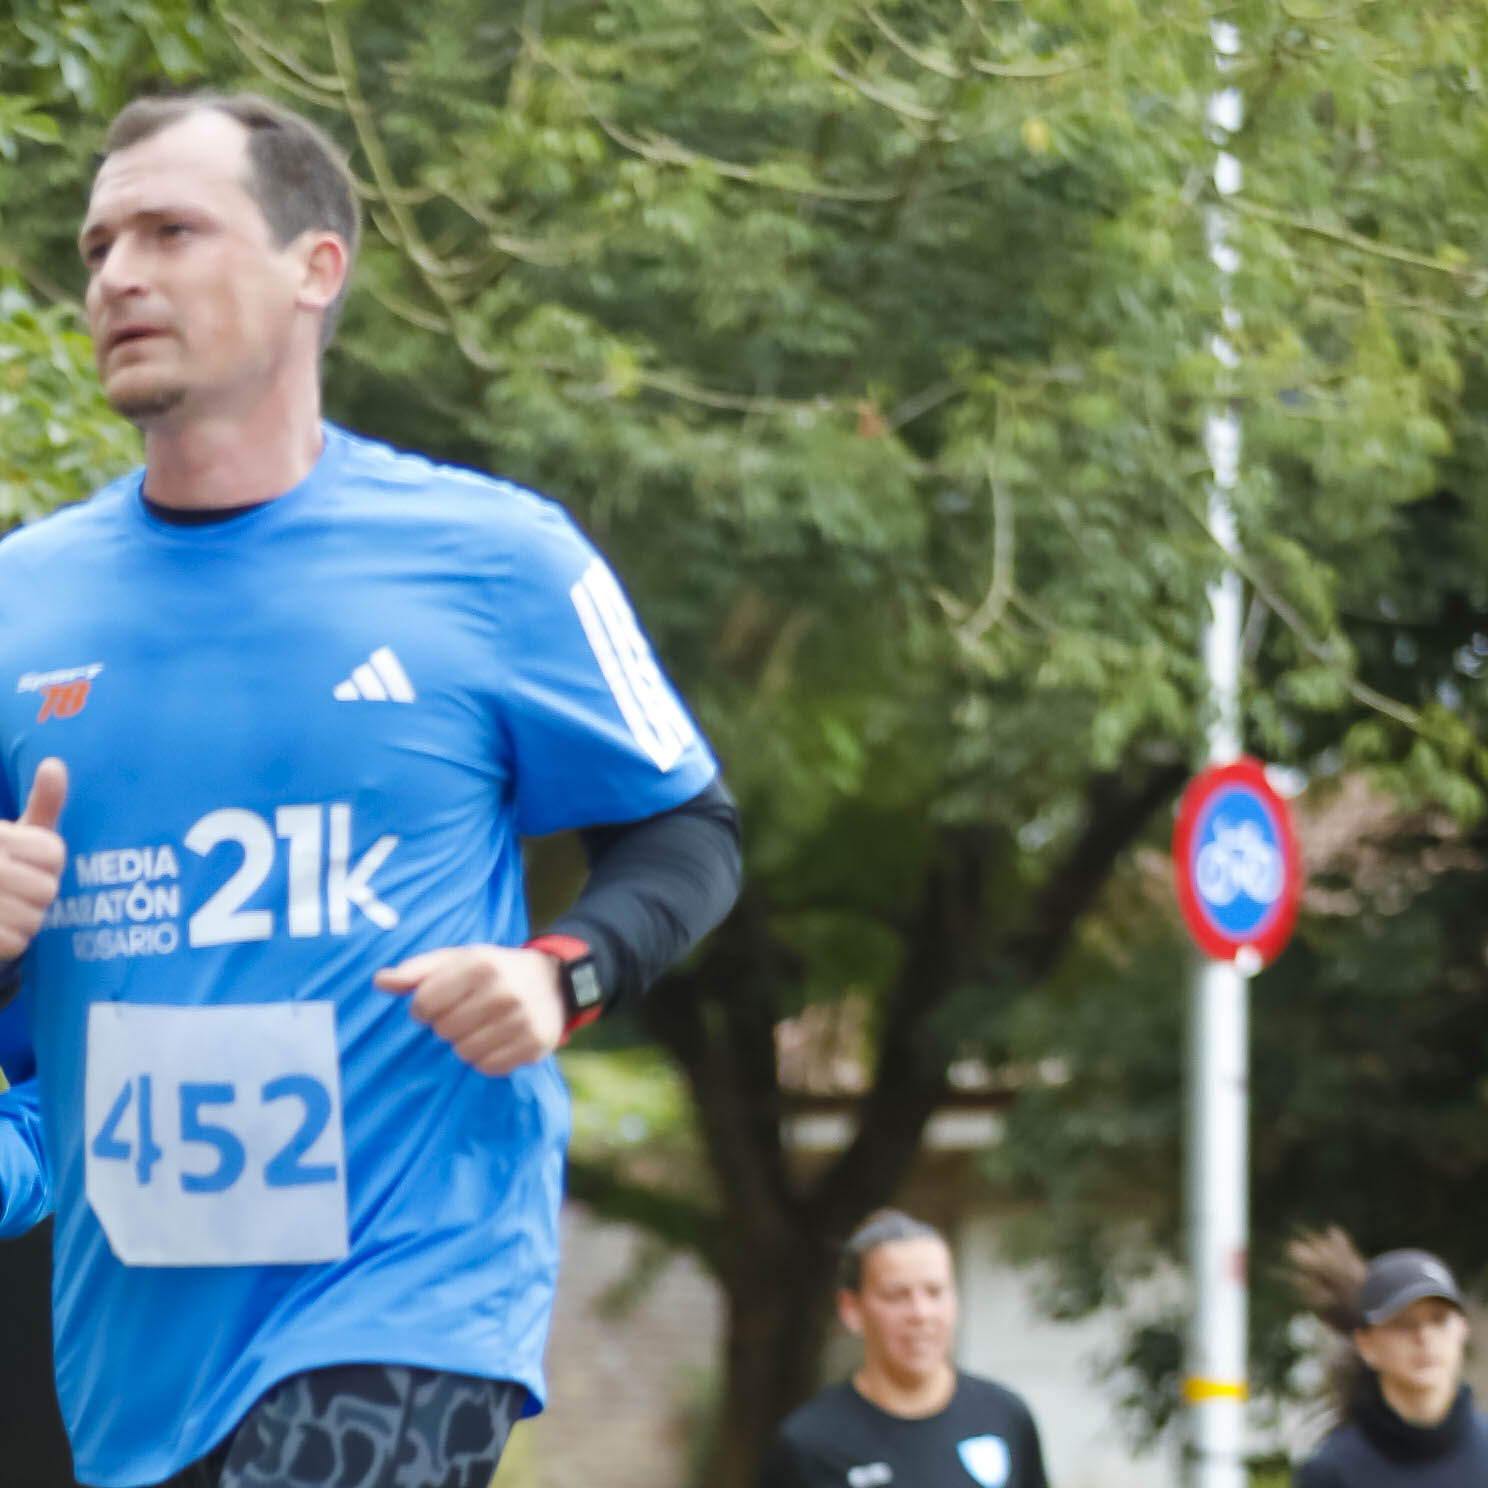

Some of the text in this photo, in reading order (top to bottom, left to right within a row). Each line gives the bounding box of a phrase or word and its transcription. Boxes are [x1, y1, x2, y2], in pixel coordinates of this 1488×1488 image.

[75, 845, 179, 887] MEDIA
[184, 803, 400, 948] 21k
[91, 1072, 338, 1194] 452
